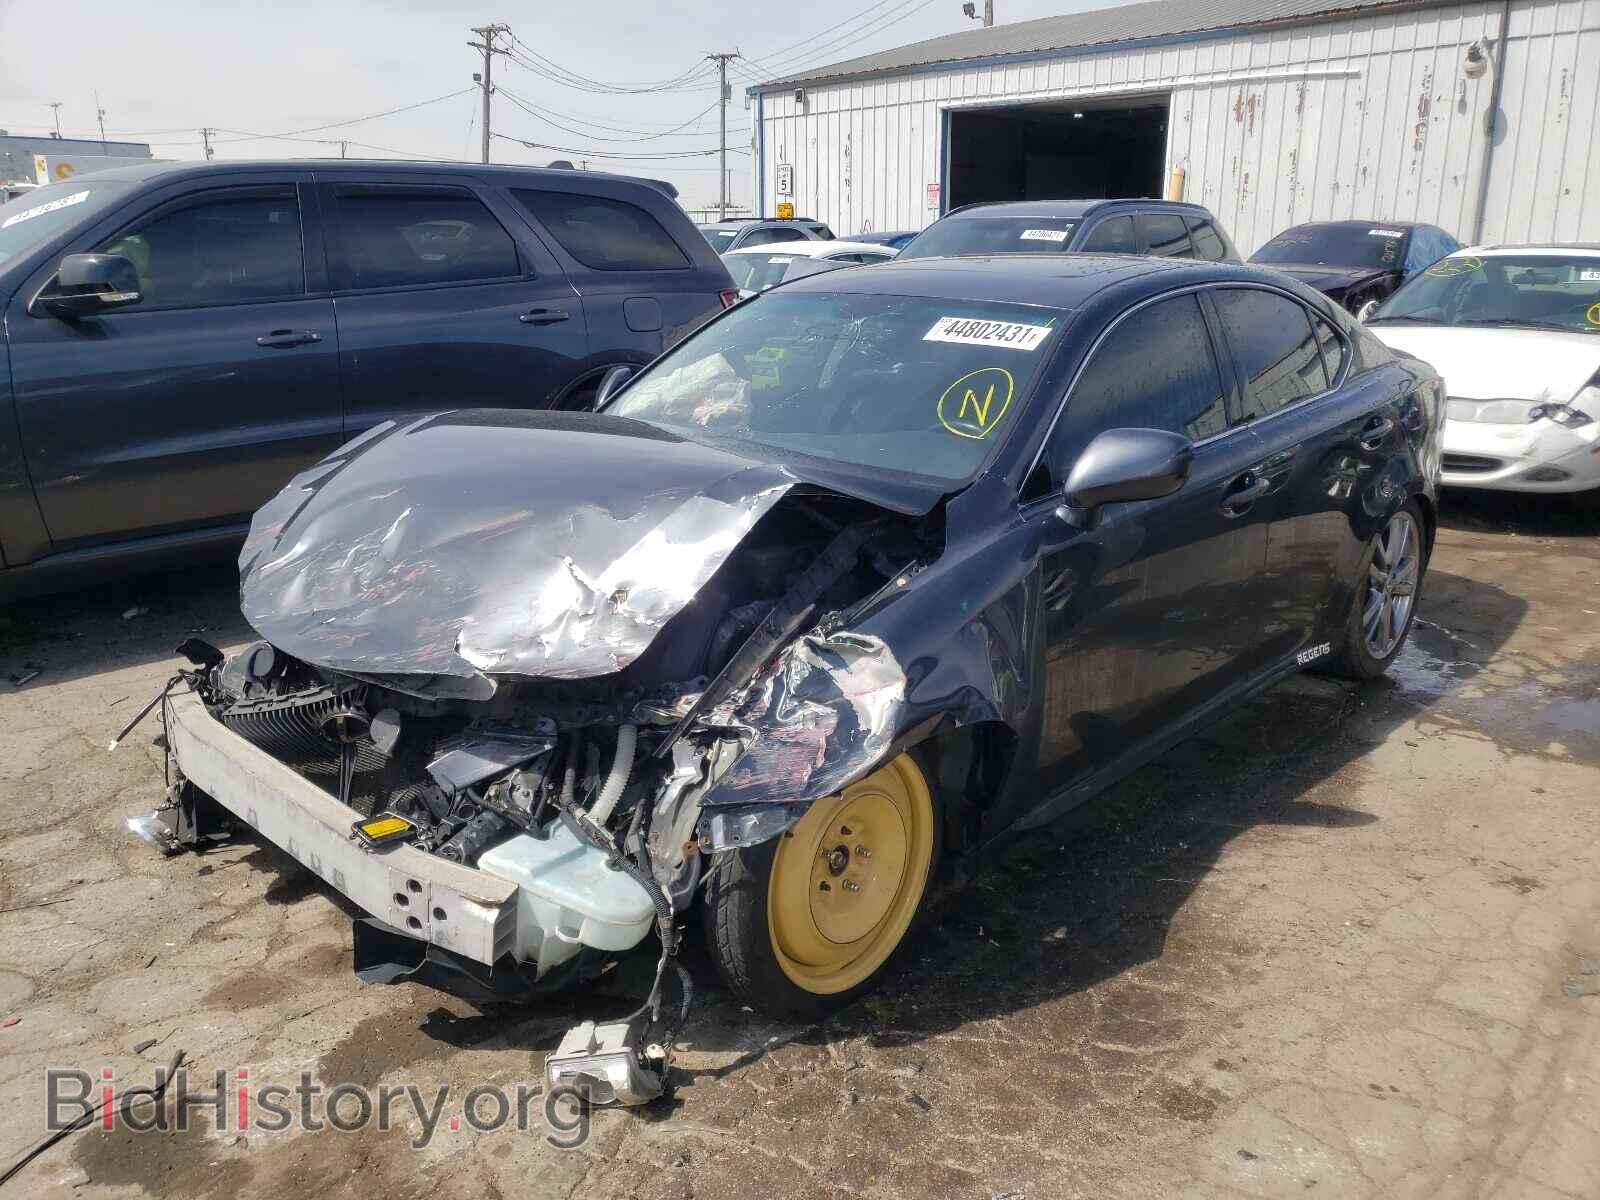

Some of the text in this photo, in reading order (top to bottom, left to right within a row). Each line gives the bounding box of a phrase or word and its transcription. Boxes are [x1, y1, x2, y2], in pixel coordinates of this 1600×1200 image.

[781, 180, 787, 191] 5
[944, 320, 1033, 343] 44802431
[960, 384, 994, 426] N
